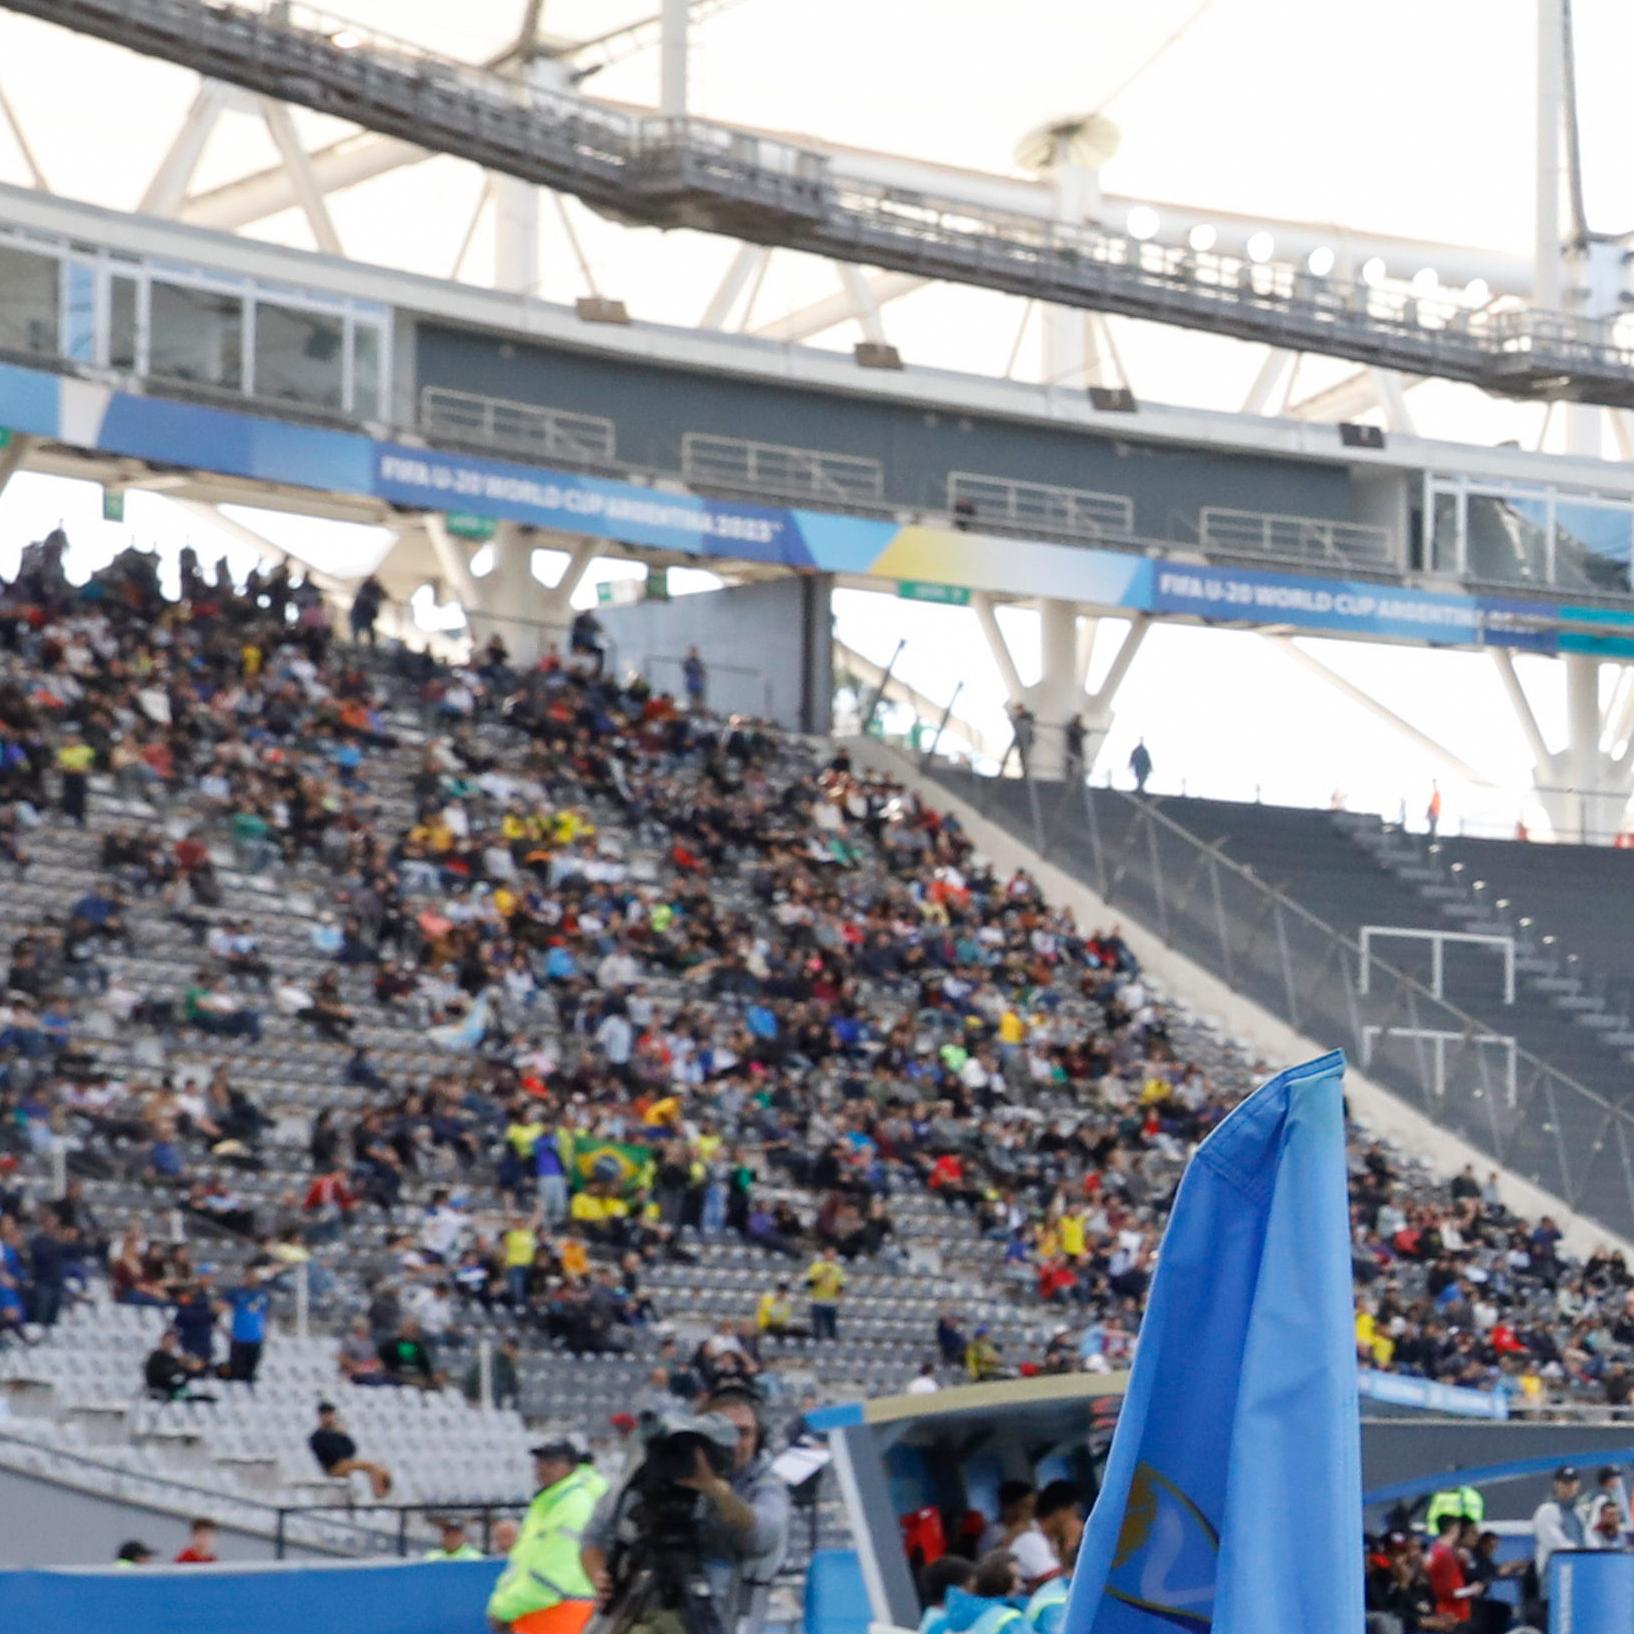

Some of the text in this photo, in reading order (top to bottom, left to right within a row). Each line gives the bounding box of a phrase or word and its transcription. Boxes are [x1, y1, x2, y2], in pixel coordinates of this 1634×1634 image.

[381, 455, 430, 486] FIFA
[483, 472, 561, 510] WORLD
[562, 486, 603, 516] CUP
[1159, 573, 1201, 600] FIFA
[1204, 578, 1251, 604] U-20
[1254, 584, 1333, 613] WORLD
[1333, 591, 1377, 616] CUP
